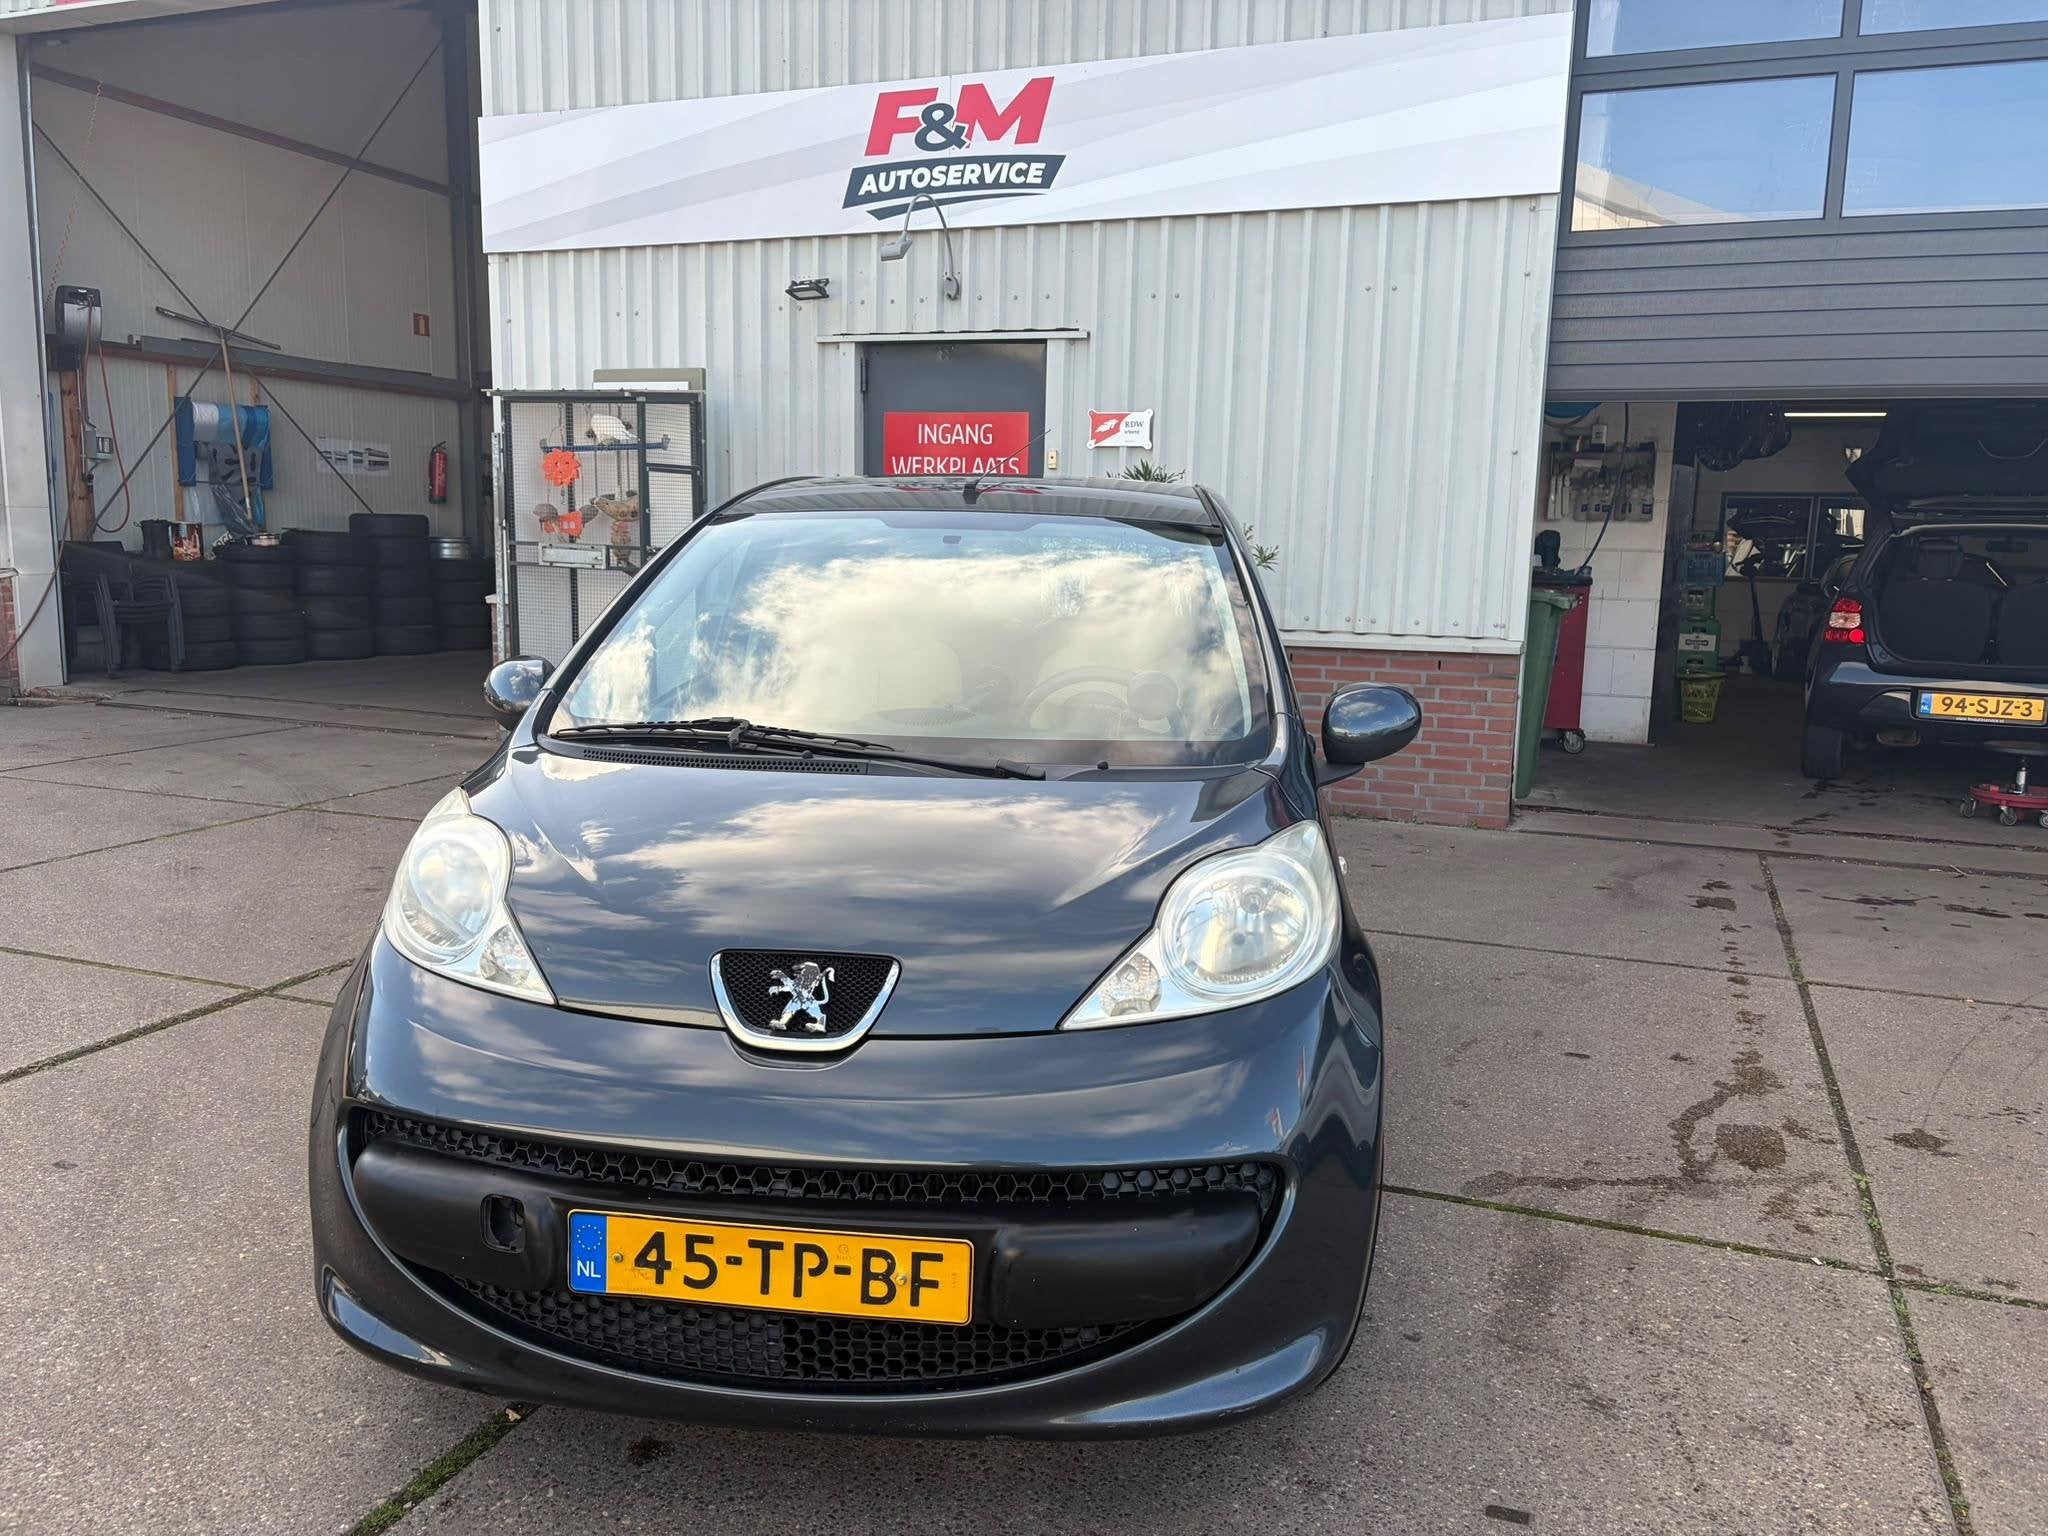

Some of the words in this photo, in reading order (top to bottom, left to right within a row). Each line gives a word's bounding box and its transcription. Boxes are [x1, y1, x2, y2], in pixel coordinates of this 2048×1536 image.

[864, 76, 1055, 156] F&M
[858, 162, 1047, 196] AUTOSERVICE
[918, 423, 993, 445] INGANG
[1125, 420, 1144, 428] RDW
[891, 456, 1020, 475] WERKPLAATS
[1941, 696, 2033, 717] 94-SJZ-3
[577, 1259, 601, 1279] NL
[633, 1231, 944, 1307] 45-TP-BF
